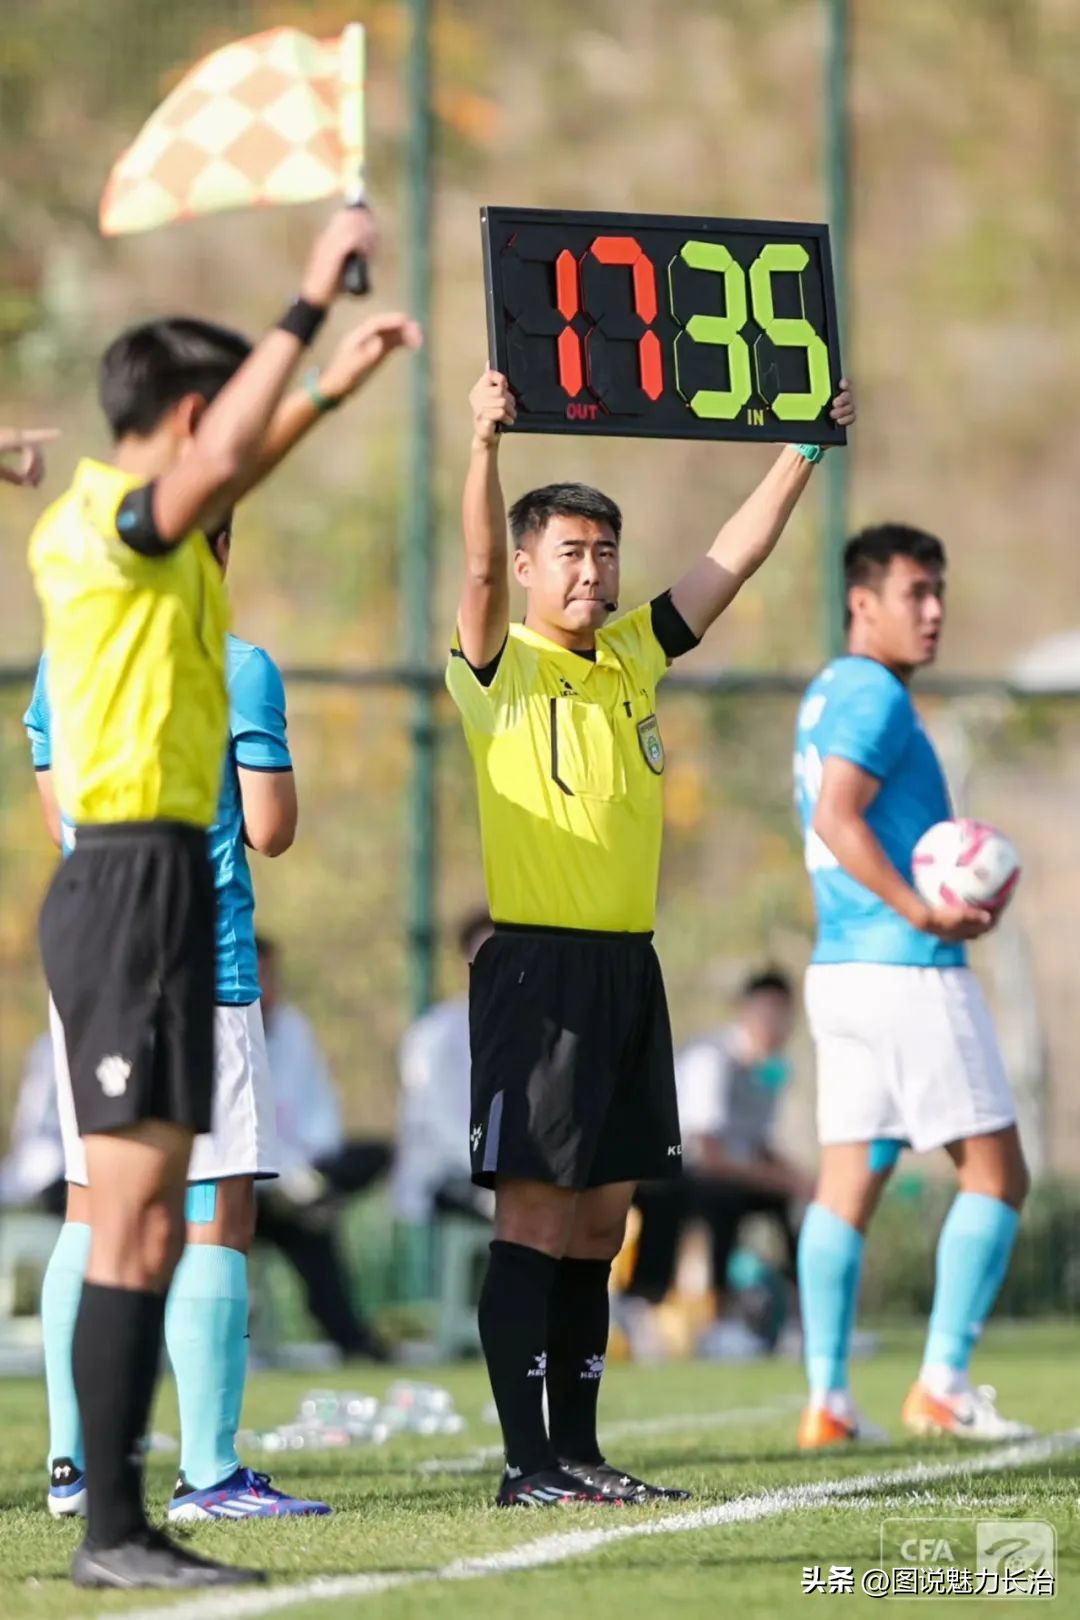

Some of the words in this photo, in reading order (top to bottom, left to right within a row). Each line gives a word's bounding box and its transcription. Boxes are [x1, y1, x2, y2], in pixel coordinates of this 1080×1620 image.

[556, 236, 663, 400] 17
[680, 240, 831, 420] 35
[566, 403, 598, 420] OUT
[746, 408, 765, 426] IN
[527, 1369, 546, 1377] KEL
